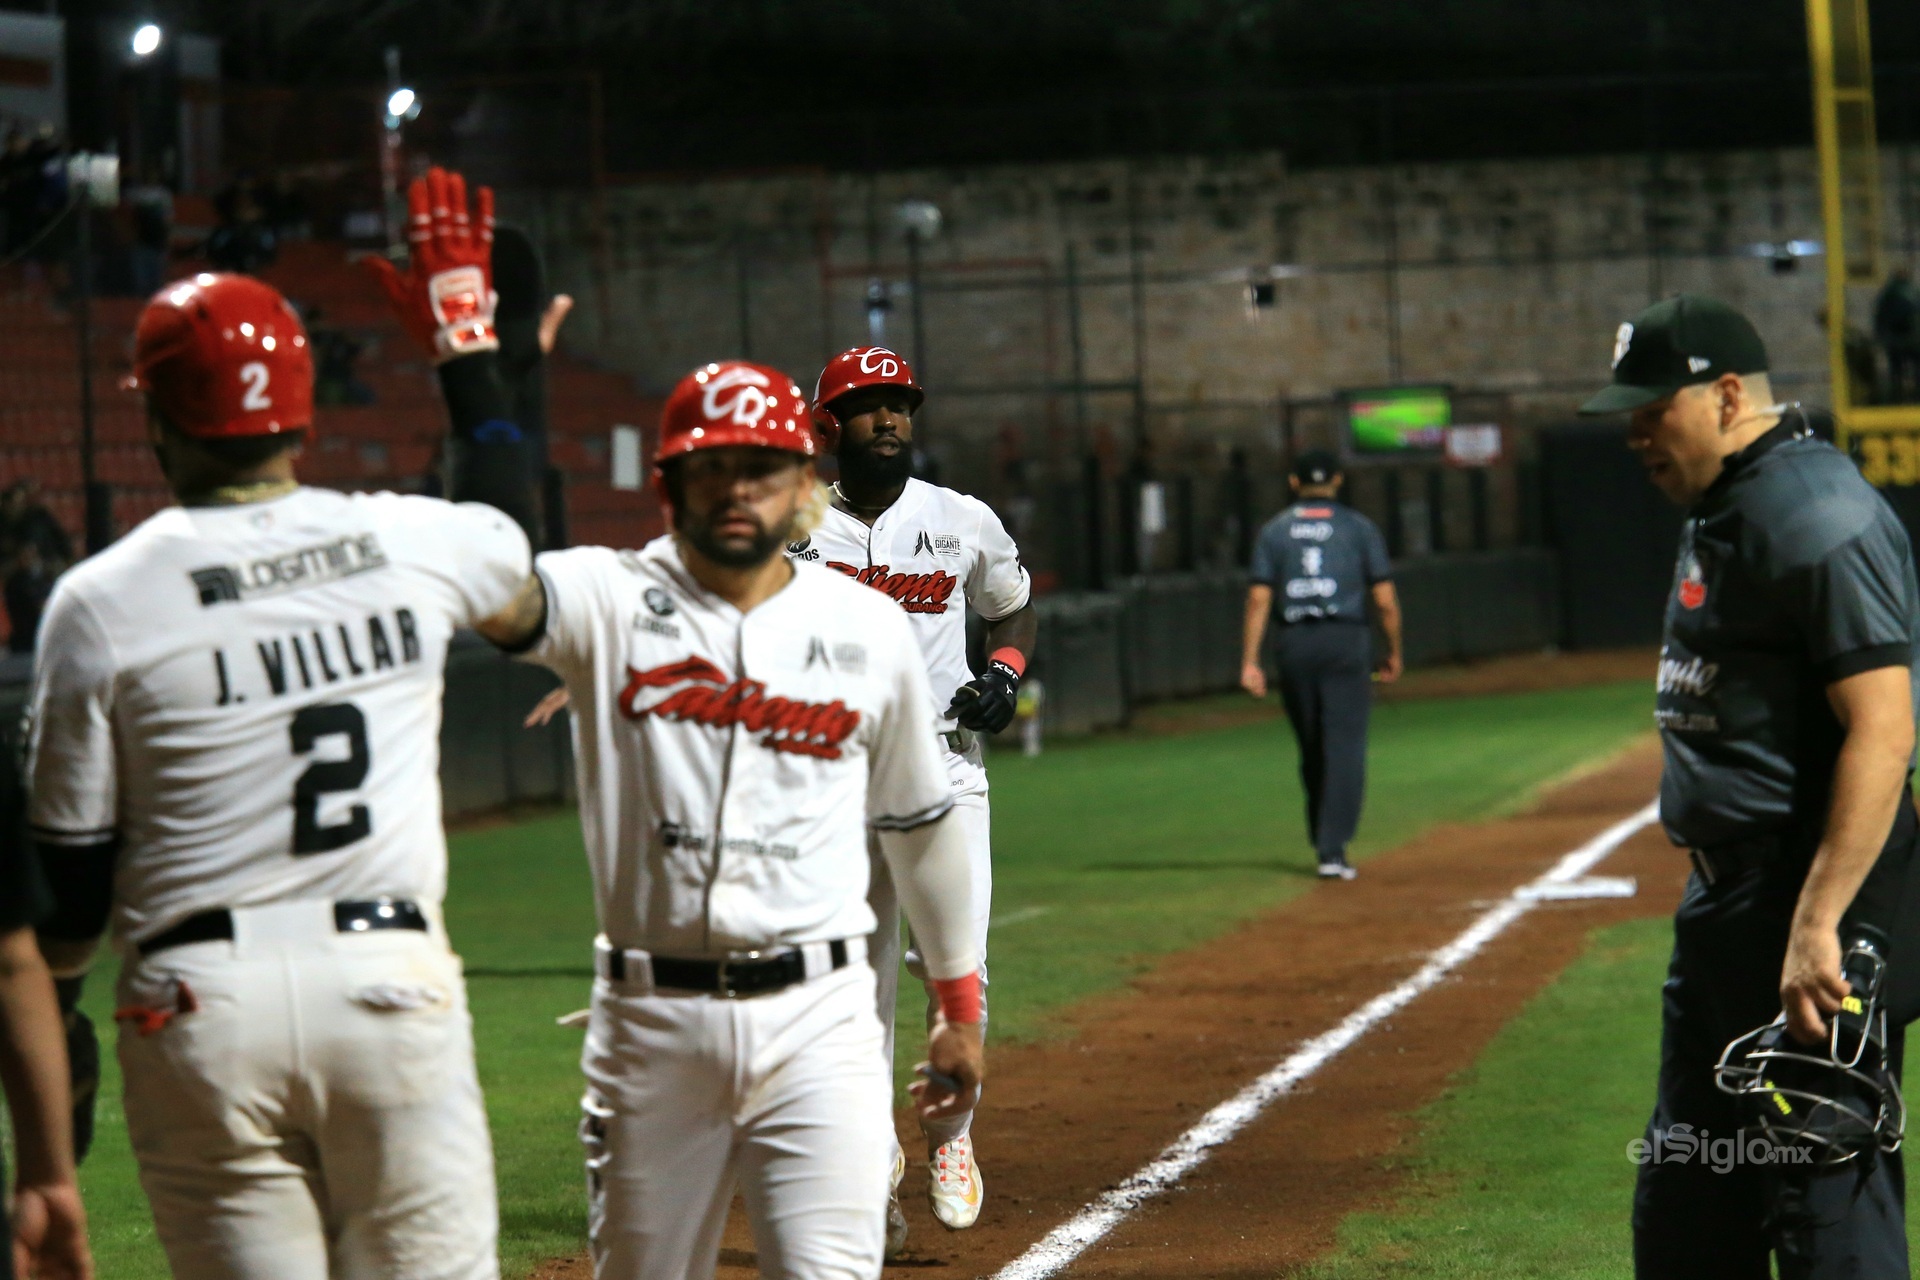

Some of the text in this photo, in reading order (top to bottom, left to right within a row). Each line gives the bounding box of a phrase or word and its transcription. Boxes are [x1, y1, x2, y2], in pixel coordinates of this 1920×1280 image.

[240, 361, 272, 411] 2
[934, 539, 961, 551] GIGANTE
[215, 607, 421, 706] J. VILLAR
[619, 653, 862, 749] Caliente
[289, 703, 373, 857] 2
